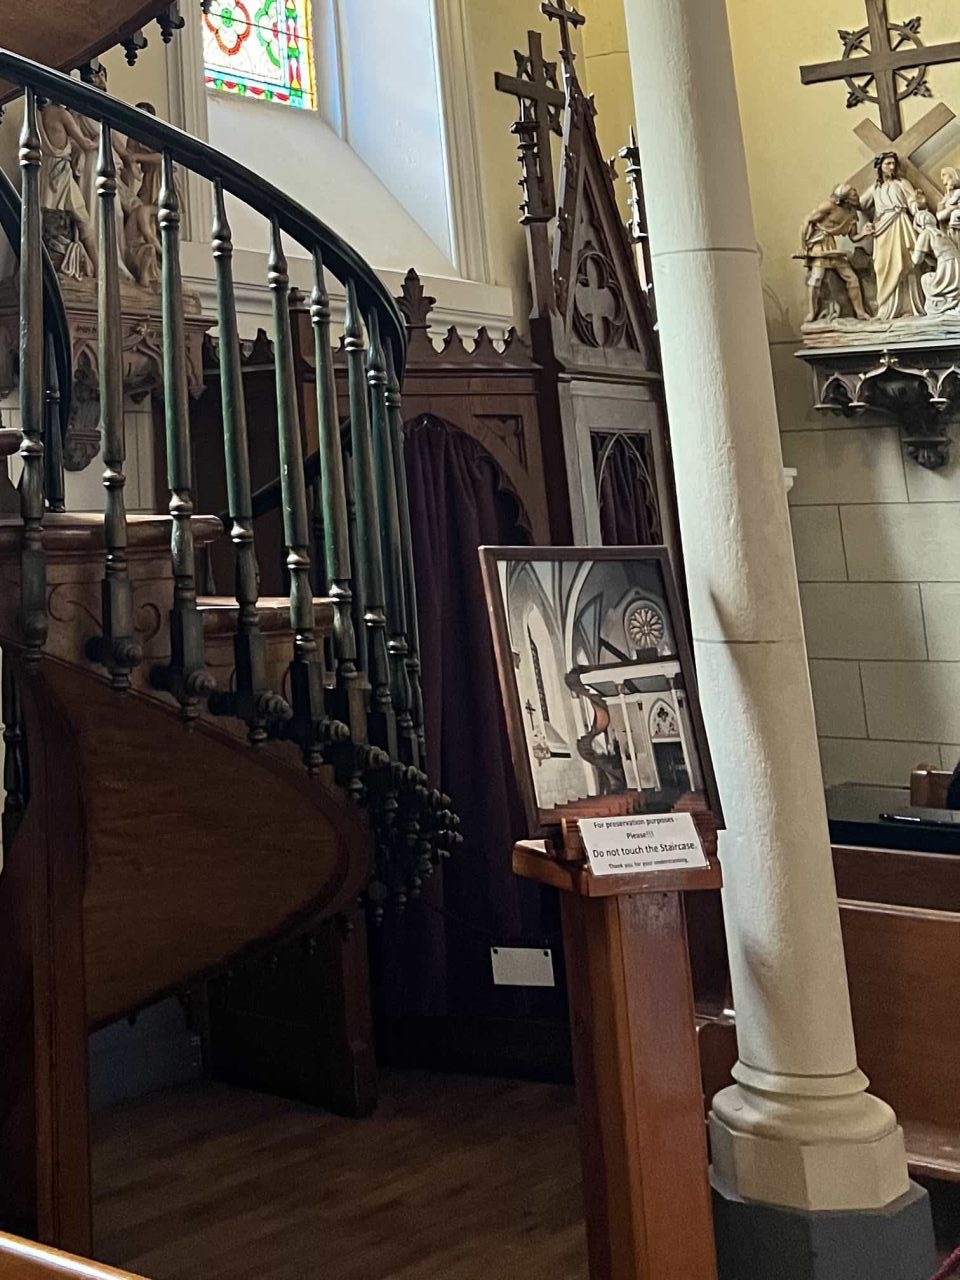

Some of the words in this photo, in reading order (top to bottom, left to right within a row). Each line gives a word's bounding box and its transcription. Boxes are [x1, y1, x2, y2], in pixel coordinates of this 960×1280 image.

[594, 821, 604, 829] For
[606, 819, 645, 829] preservation
[593, 849, 605, 858] Do
[606, 848, 620, 857] not
[621, 845, 644, 856] touch
[645, 843, 659, 853] the
[659, 842, 698, 852] Staircase.
